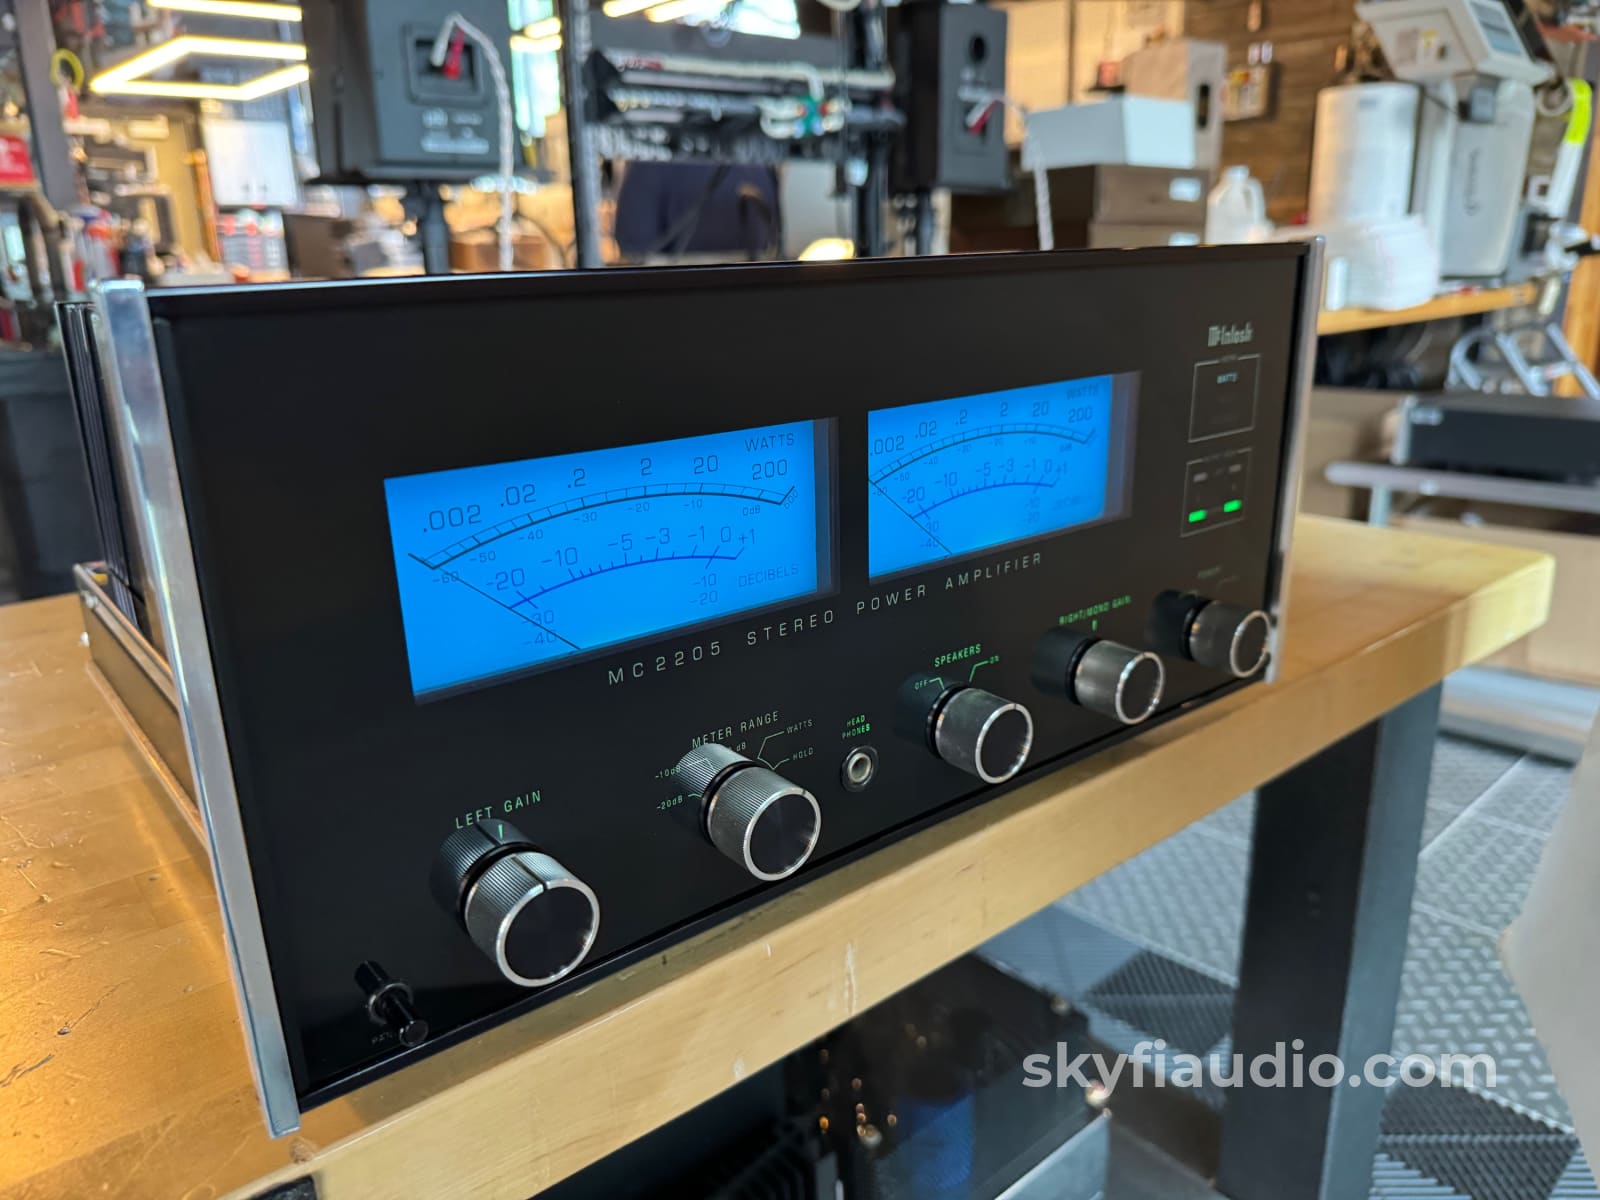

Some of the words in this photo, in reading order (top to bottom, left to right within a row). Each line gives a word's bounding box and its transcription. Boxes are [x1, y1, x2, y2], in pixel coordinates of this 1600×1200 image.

[869, 435, 905, 457] .002
[915, 420, 938, 439] .02
[955, 408, 969, 425] .2
[999, 401, 1009, 417] 2
[1032, 400, 1049, 417] 20
[1067, 404, 1094, 423] 200
[744, 432, 795, 453] WATTS
[901, 485, 926, 504] -20
[934, 471, 958, 488] -10
[975, 461, 992, 477] -5
[997, 457, 1015, 473] -3
[1044, 458, 1053, 474] 0
[423, 504, 482, 533] .002
[500, 483, 537, 508] .02
[567, 468, 587, 489] .2
[640, 457, 652, 477] 2
[693, 454, 719, 475] 20
[751, 458, 788, 481] 200
[469, 550, 497, 564] -50
[517, 528, 544, 541] -40
[573, 511, 598, 524] -30
[627, 501, 650, 513] -20
[684, 499, 703, 510] -10
[486, 567, 526, 591] -20
[541, 546, 579, 567] -10
[608, 533, 633, 551] -5
[645, 527, 671, 545] -3
[687, 525, 705, 542] -1
[720, 525, 732, 543] 0
[738, 528, 756, 545] +1
[692, 573, 718, 588] -10
[738, 563, 800, 588] DECIBELS
[689, 590, 719, 606] -20
[746, 609, 834, 646] STEREO
[856, 583, 927, 615] POWER
[944, 552, 1042, 590] AMPLIFIER
[1058, 600, 1110, 625] RIGHT/MONO
[1111, 594, 1132, 609] GAIN
[933, 643, 982, 668] SPEAKERS
[914, 679, 928, 691] OFF
[691, 726, 733, 749] METER
[740, 710, 780, 734] RANGE
[786, 719, 814, 735] WATTS
[841, 723, 871, 740] PHONES
[846, 714, 866, 728] HEAD
[792, 746, 815, 761] HOLD
[654, 765, 682, 780] -10dB
[455, 806, 493, 830] LEFT
[503, 789, 542, 813] GAIN
[656, 794, 684, 811] -20dB
